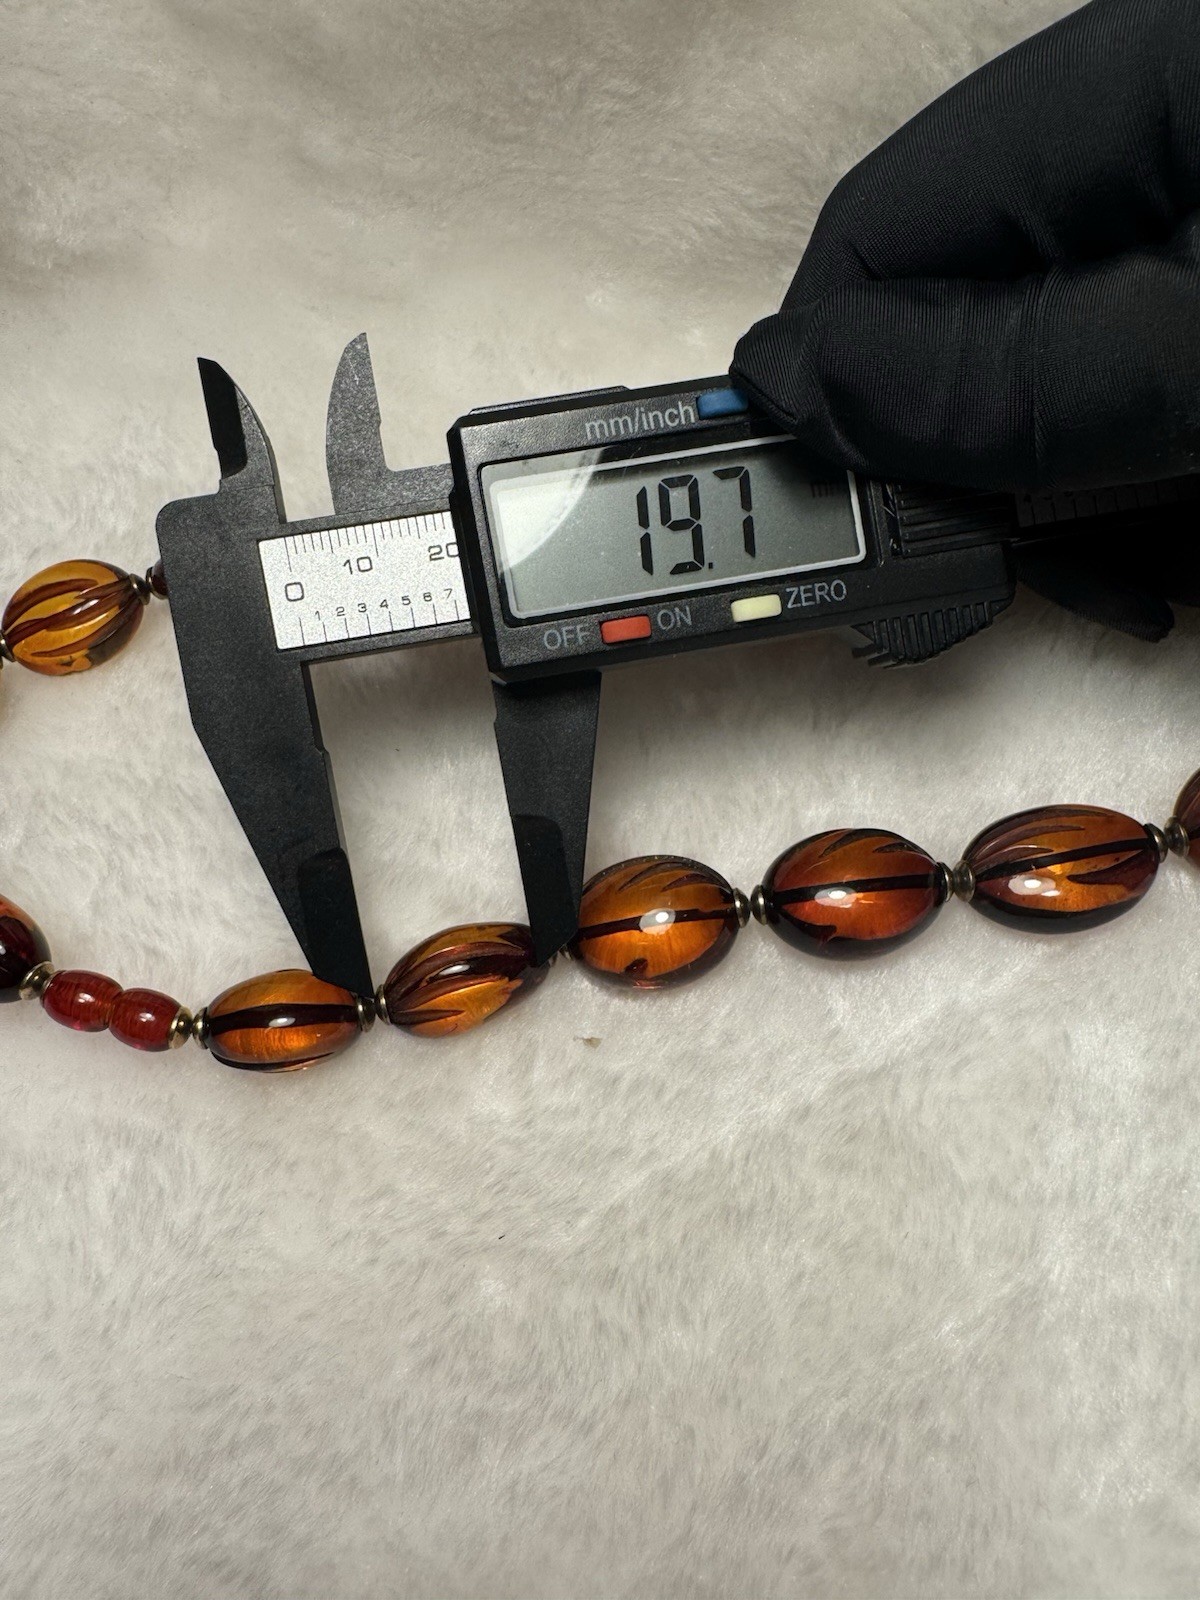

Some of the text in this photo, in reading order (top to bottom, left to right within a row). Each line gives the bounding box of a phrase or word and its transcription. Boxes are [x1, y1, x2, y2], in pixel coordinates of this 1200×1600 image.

[584, 401, 696, 441] mm/inch
[636, 466, 757, 576] 19.7
[343, 542, 459, 575] 10 20
[284, 581, 305, 602] 0
[314, 610, 322, 621] 1
[335, 606, 346, 617] 2
[357, 602, 368, 613] 3
[379, 599, 389, 610] 4
[401, 595, 412, 606] 5
[444, 588, 453, 599] 7
[543, 579, 847, 652] OFF ON ZERO
